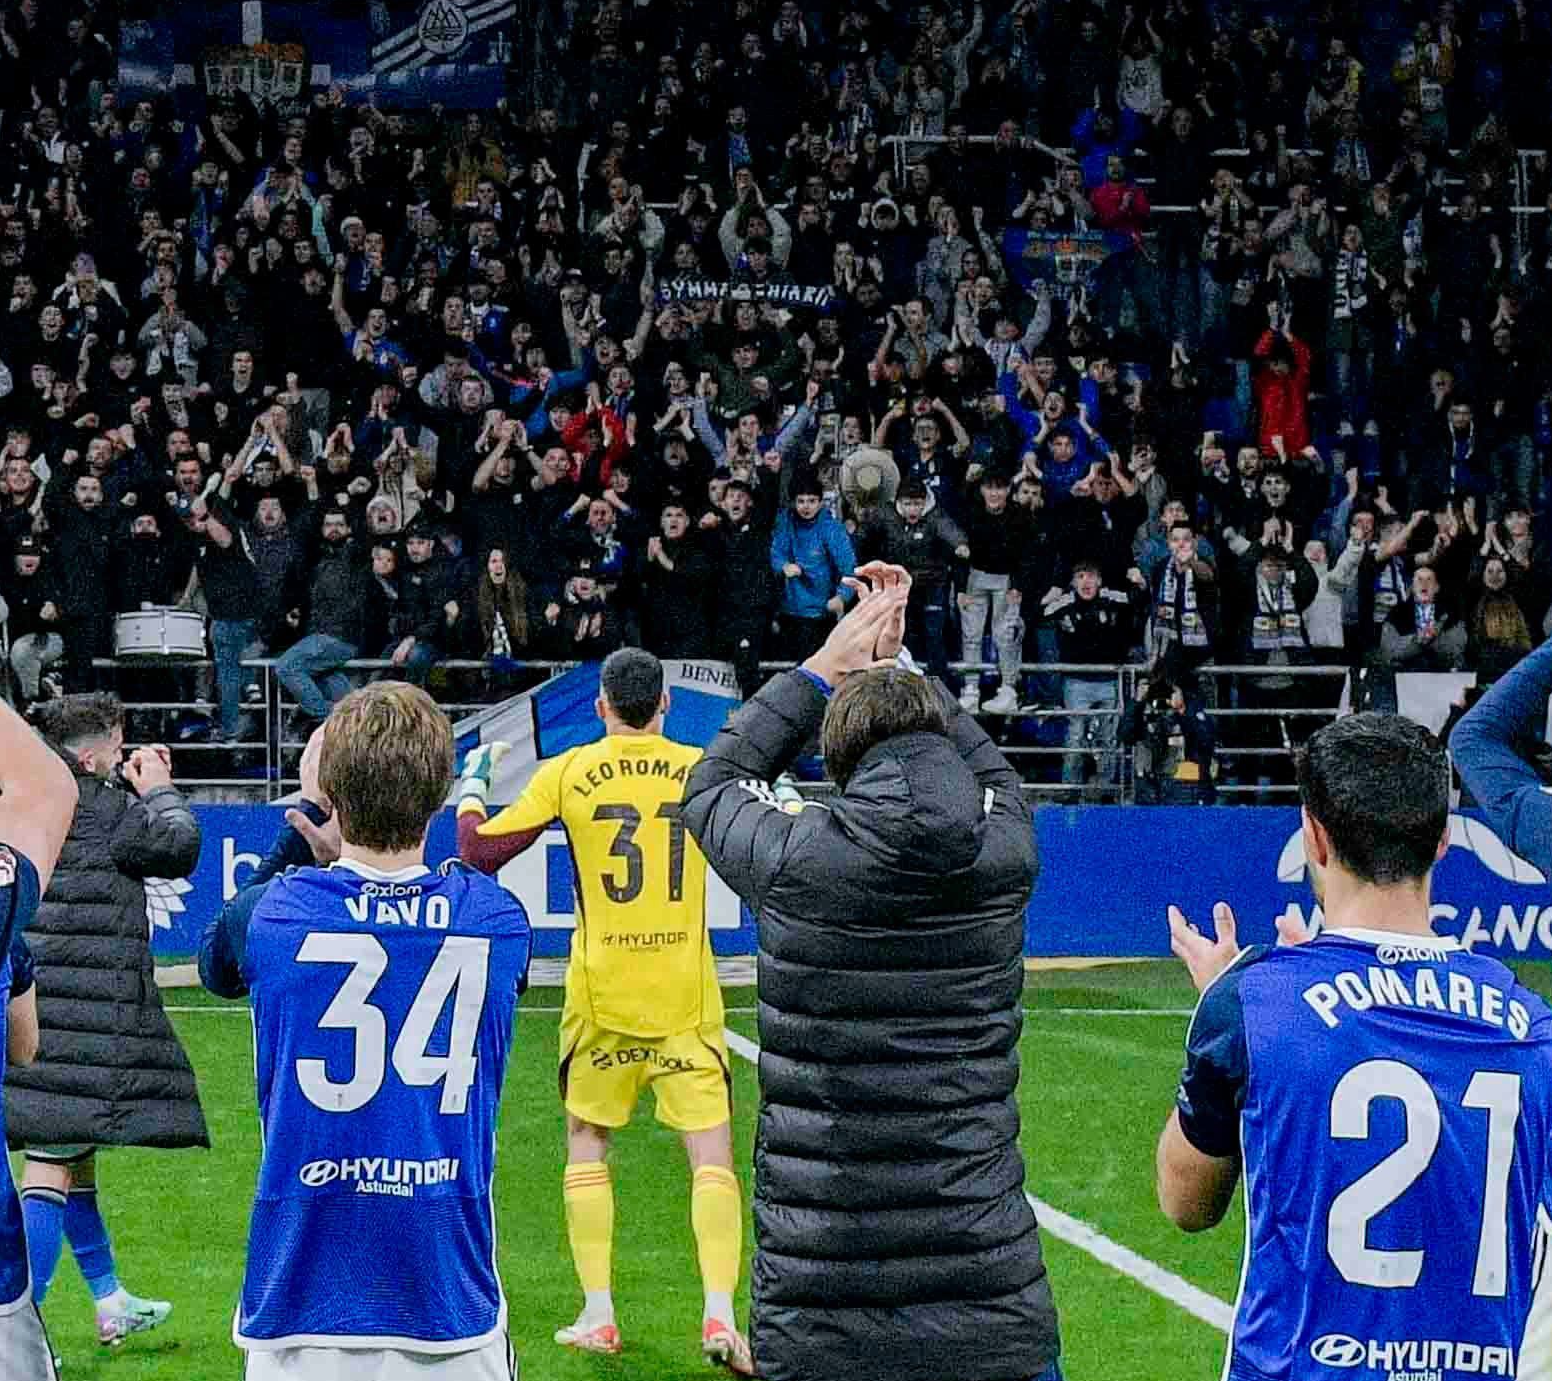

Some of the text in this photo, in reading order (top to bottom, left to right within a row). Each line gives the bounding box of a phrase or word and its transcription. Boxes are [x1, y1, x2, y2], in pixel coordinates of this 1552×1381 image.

[573, 758, 694, 798] LEO ROMA
[591, 802, 687, 904] 31
[344, 894, 452, 930] VAVO
[1301, 965, 1531, 1041] POMARES
[295, 931, 490, 1116] 34
[340, 1157, 462, 1186] HYUNDAI
[355, 1180, 414, 1198] Asturdai
[1325, 1058, 1522, 1299] 21
[1367, 1339, 1515, 1378] HYUNDAI
